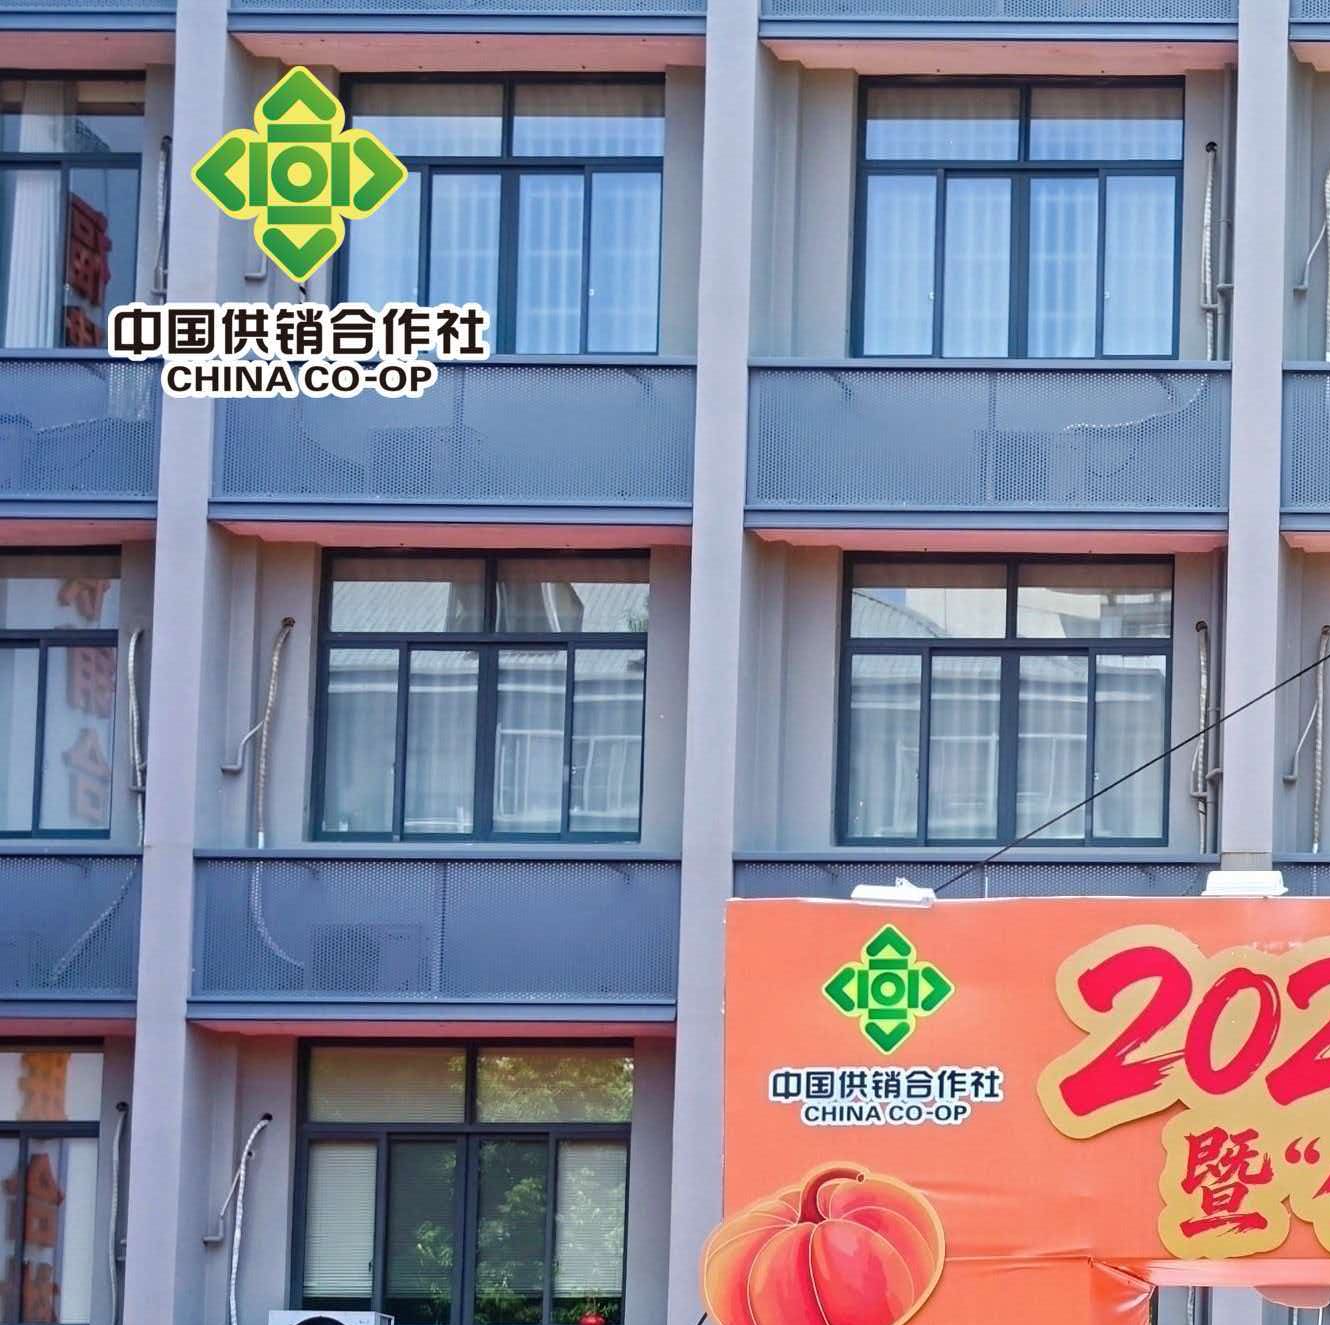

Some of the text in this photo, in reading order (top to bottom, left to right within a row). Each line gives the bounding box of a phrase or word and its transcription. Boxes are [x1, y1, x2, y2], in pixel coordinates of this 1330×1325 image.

[772, 1070, 1001, 1099] 中国供销合作社
[804, 1104, 967, 1123] CHINA CO-OP
